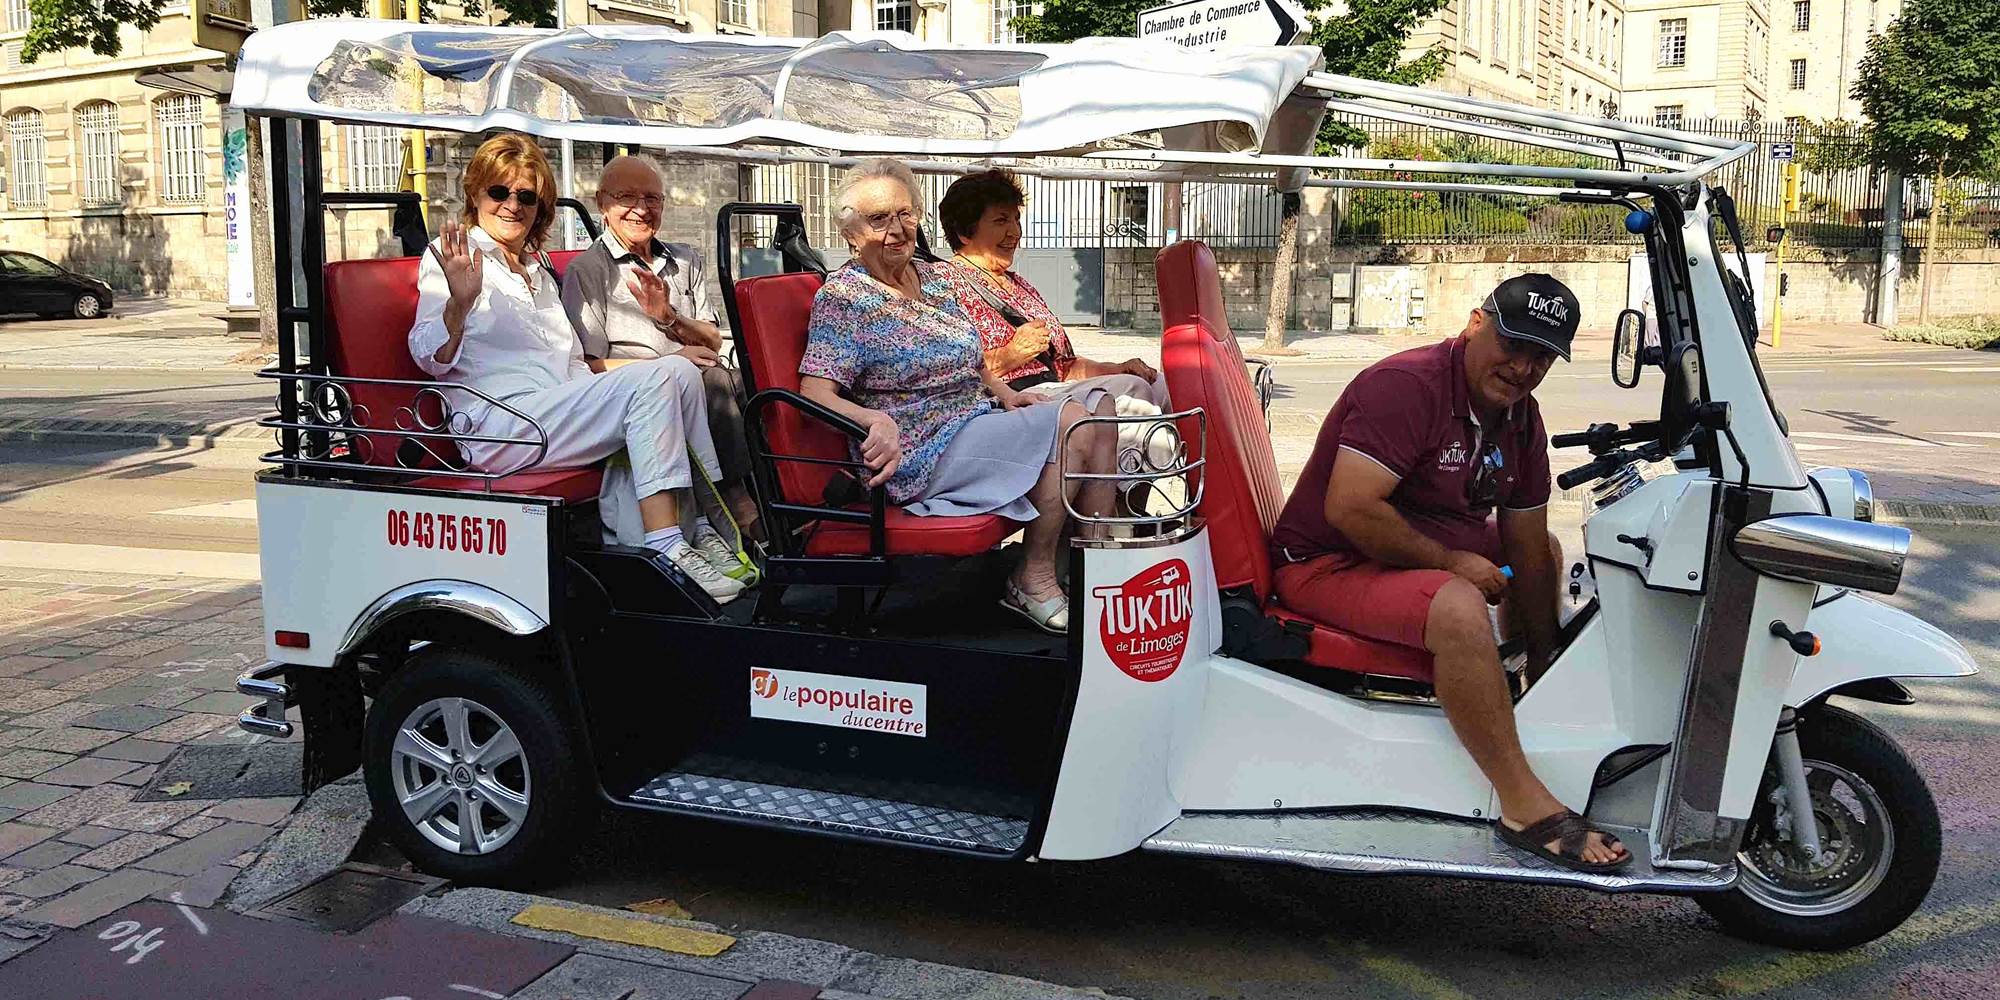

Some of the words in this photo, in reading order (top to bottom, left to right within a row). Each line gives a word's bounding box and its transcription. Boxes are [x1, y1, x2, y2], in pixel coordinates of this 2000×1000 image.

[1144, 15, 1185, 35] Chambre
[1189, 10, 1201, 25] de
[1206, 0, 1261, 22] Commerce
[1536, 312, 1561, 327] Limoges
[387, 509, 410, 547] 06
[413, 511, 435, 549] 43
[437, 513, 457, 551] 75
[461, 515, 483, 554] 65
[486, 518, 507, 556] 70
[1115, 642, 1129, 652] de
[1129, 631, 1184, 655] Limoges
